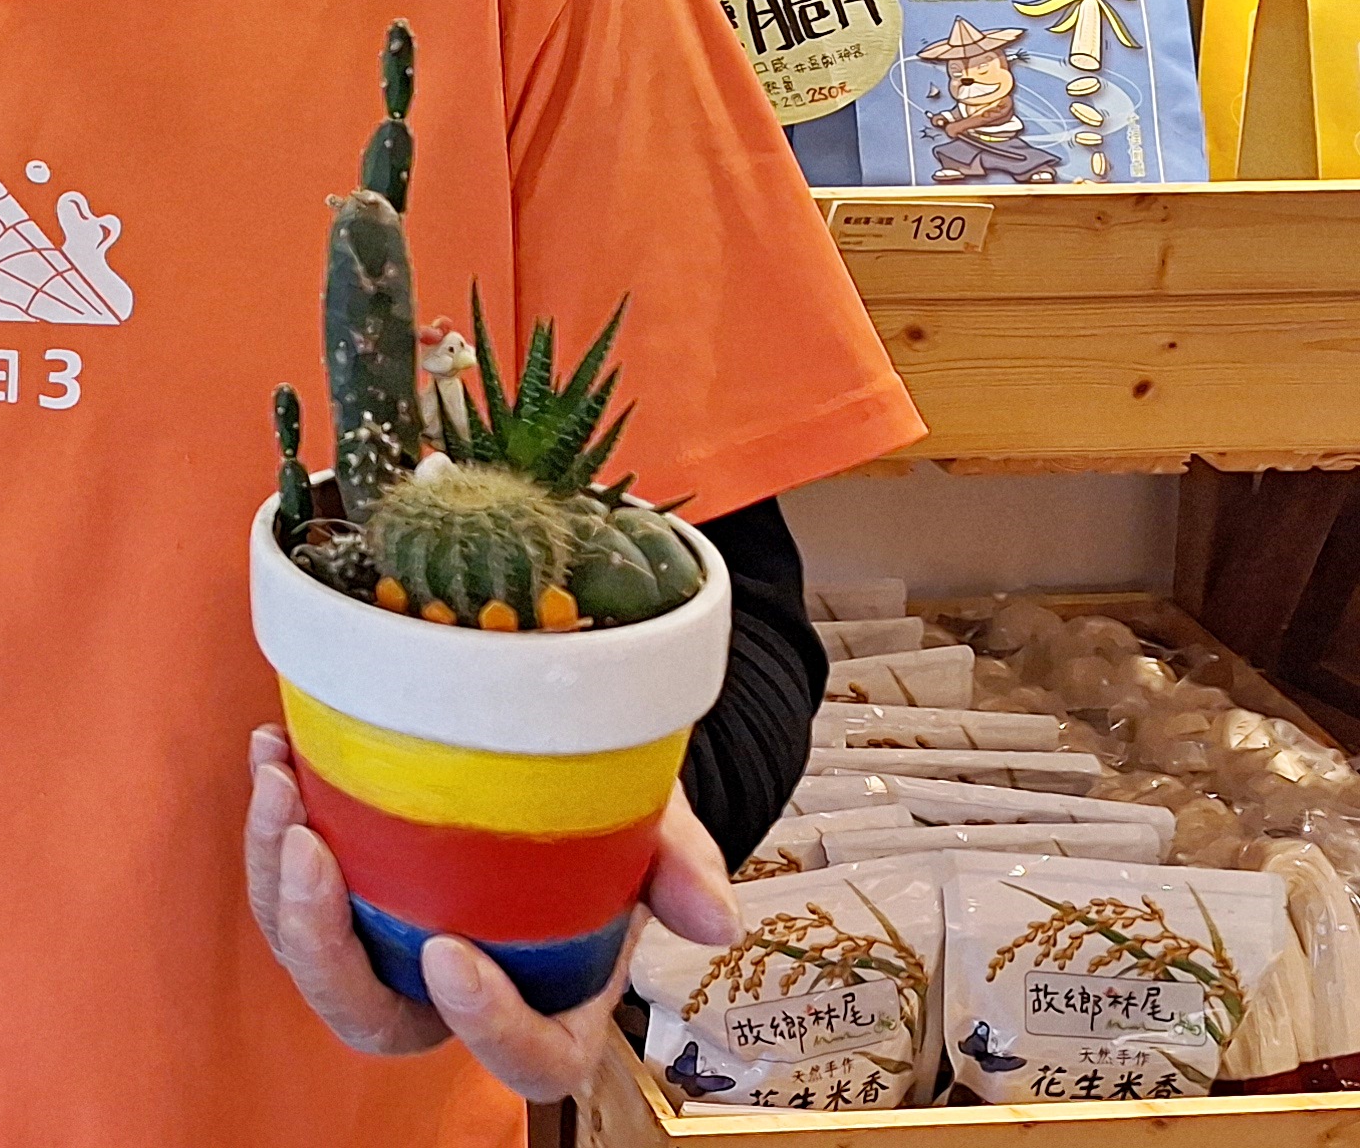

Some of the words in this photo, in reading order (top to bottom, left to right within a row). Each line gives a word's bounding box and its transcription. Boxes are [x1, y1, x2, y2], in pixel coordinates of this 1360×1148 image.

[909, 214, 967, 242] 130
[1029, 984, 1176, 1032] 故鄉林尾
[1079, 1047, 1151, 1066] 天然手作
